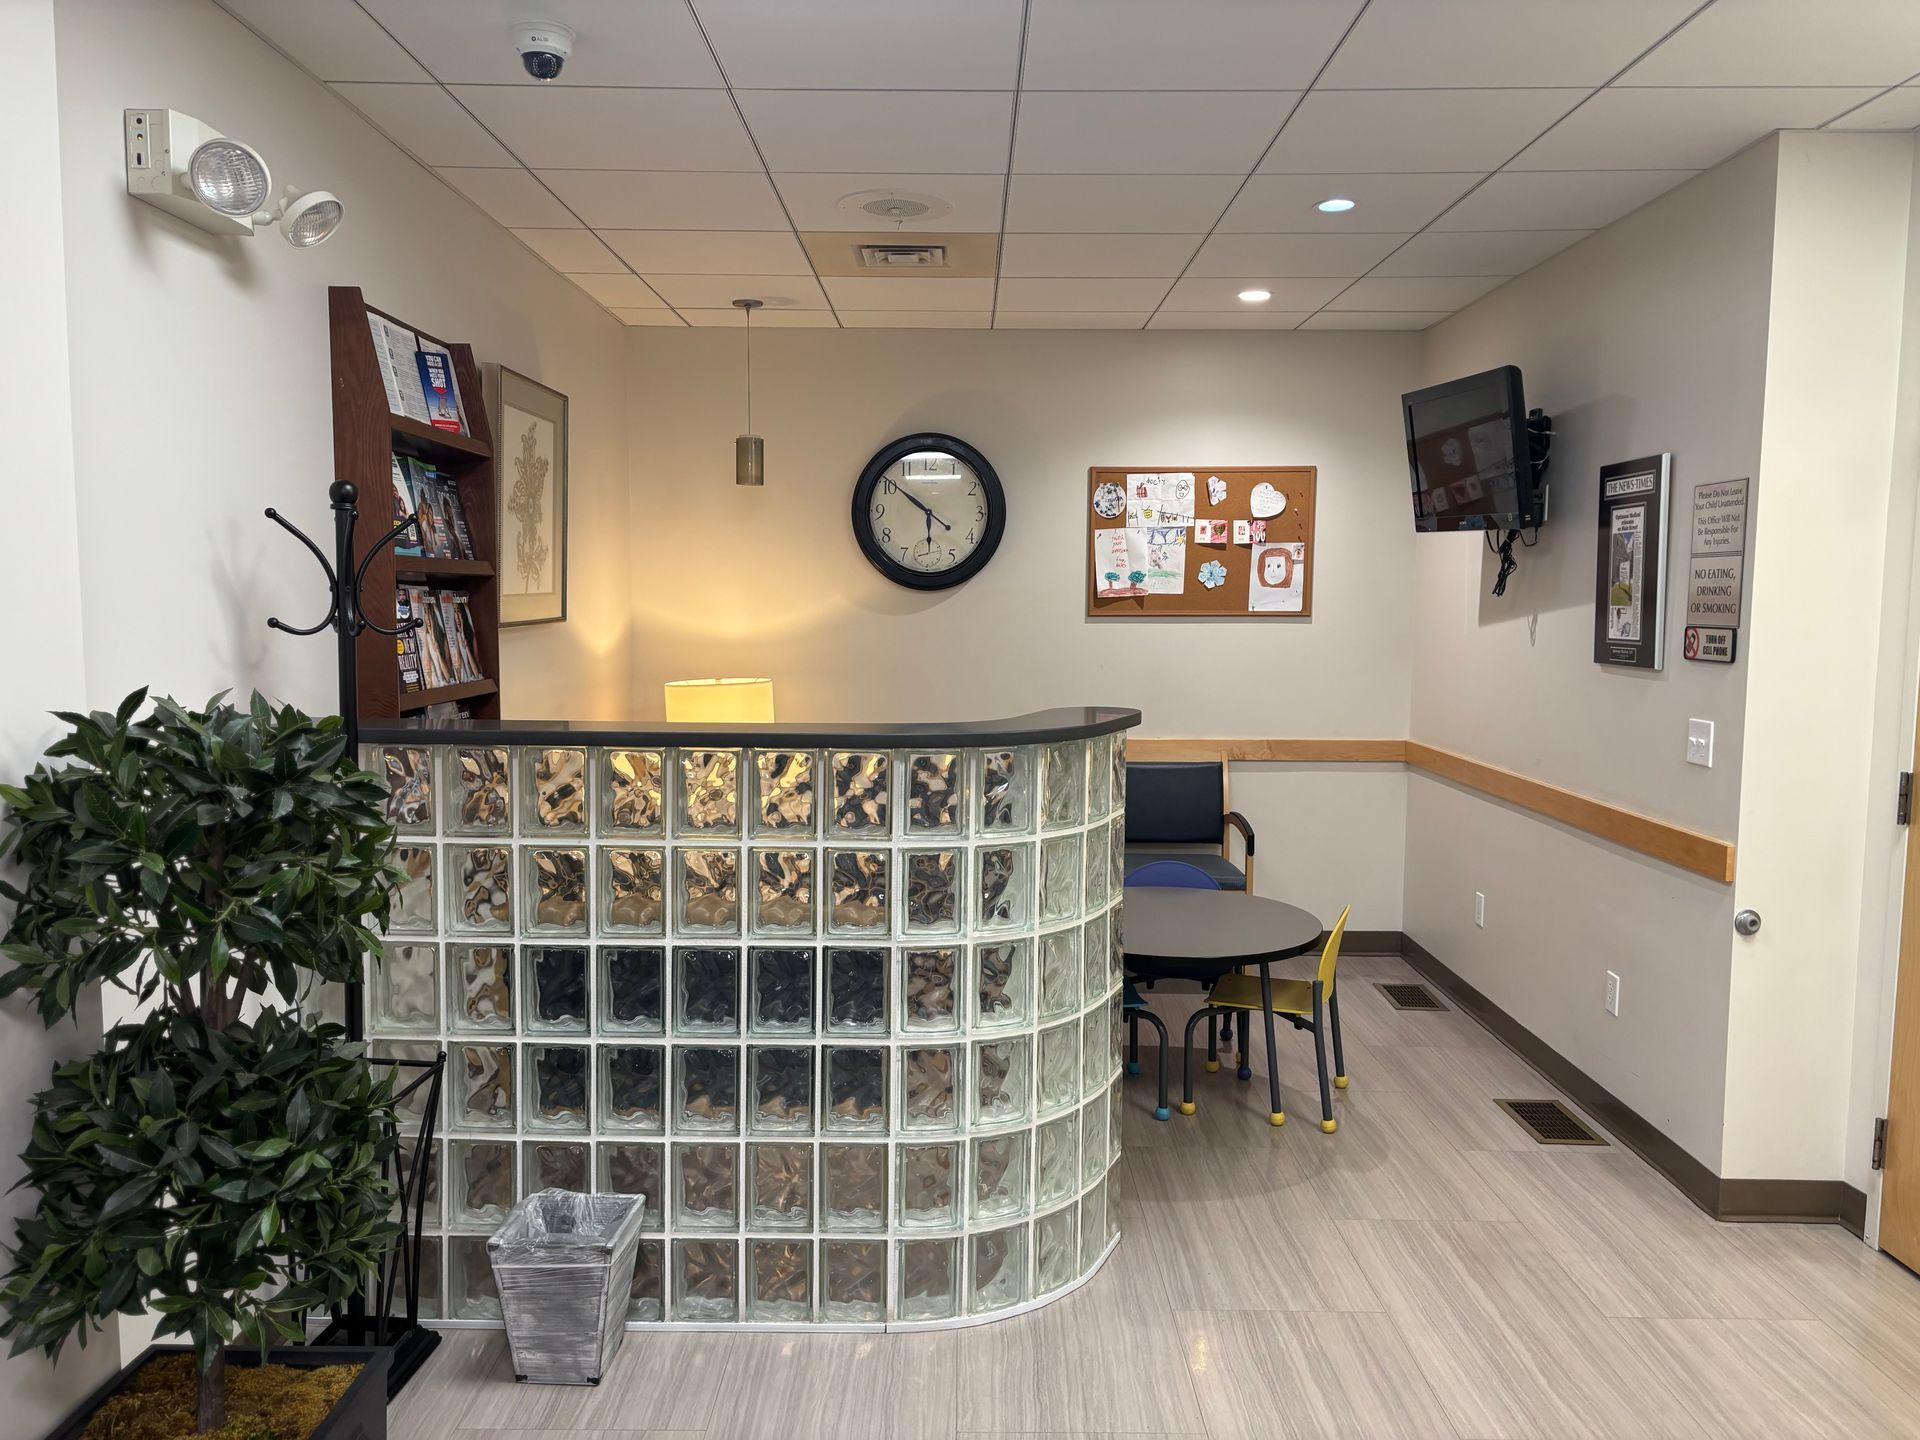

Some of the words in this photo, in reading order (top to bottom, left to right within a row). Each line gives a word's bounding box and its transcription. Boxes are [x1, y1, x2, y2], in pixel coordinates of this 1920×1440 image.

[431, 378, 446, 388] SHOT
[901, 462, 912, 476] 11
[924, 458, 938, 471] 12
[951, 462, 956, 476] 1
[882, 480, 897, 495] 10
[968, 481, 977, 496] 2
[1608, 482, 1618, 494] THE
[1706, 500, 1717, 509] Child
[875, 504, 885, 520] 9
[976, 506, 984, 522] 3
[1707, 516, 1720, 524] Office
[882, 528, 891, 543] 8
[966, 528, 975, 544] 4
[1704, 526, 1729, 537] Responsible
[900, 547, 909, 561] 7
[948, 549, 956, 563] 5
[1695, 569, 1706, 579] NO
[1708, 568, 1735, 580] EATING,
[1697, 586, 1731, 596] DRINKING
[1690, 603, 1700, 613] OR
[1702, 603, 1736, 614] SMOKING
[1706, 635, 1717, 644] TURN
[1718, 636, 1726, 644] OFF
[1703, 646, 1712, 655] CELL
[1713, 646, 1728, 656] PHONE
[398, 654, 417, 670] BEAUTY
